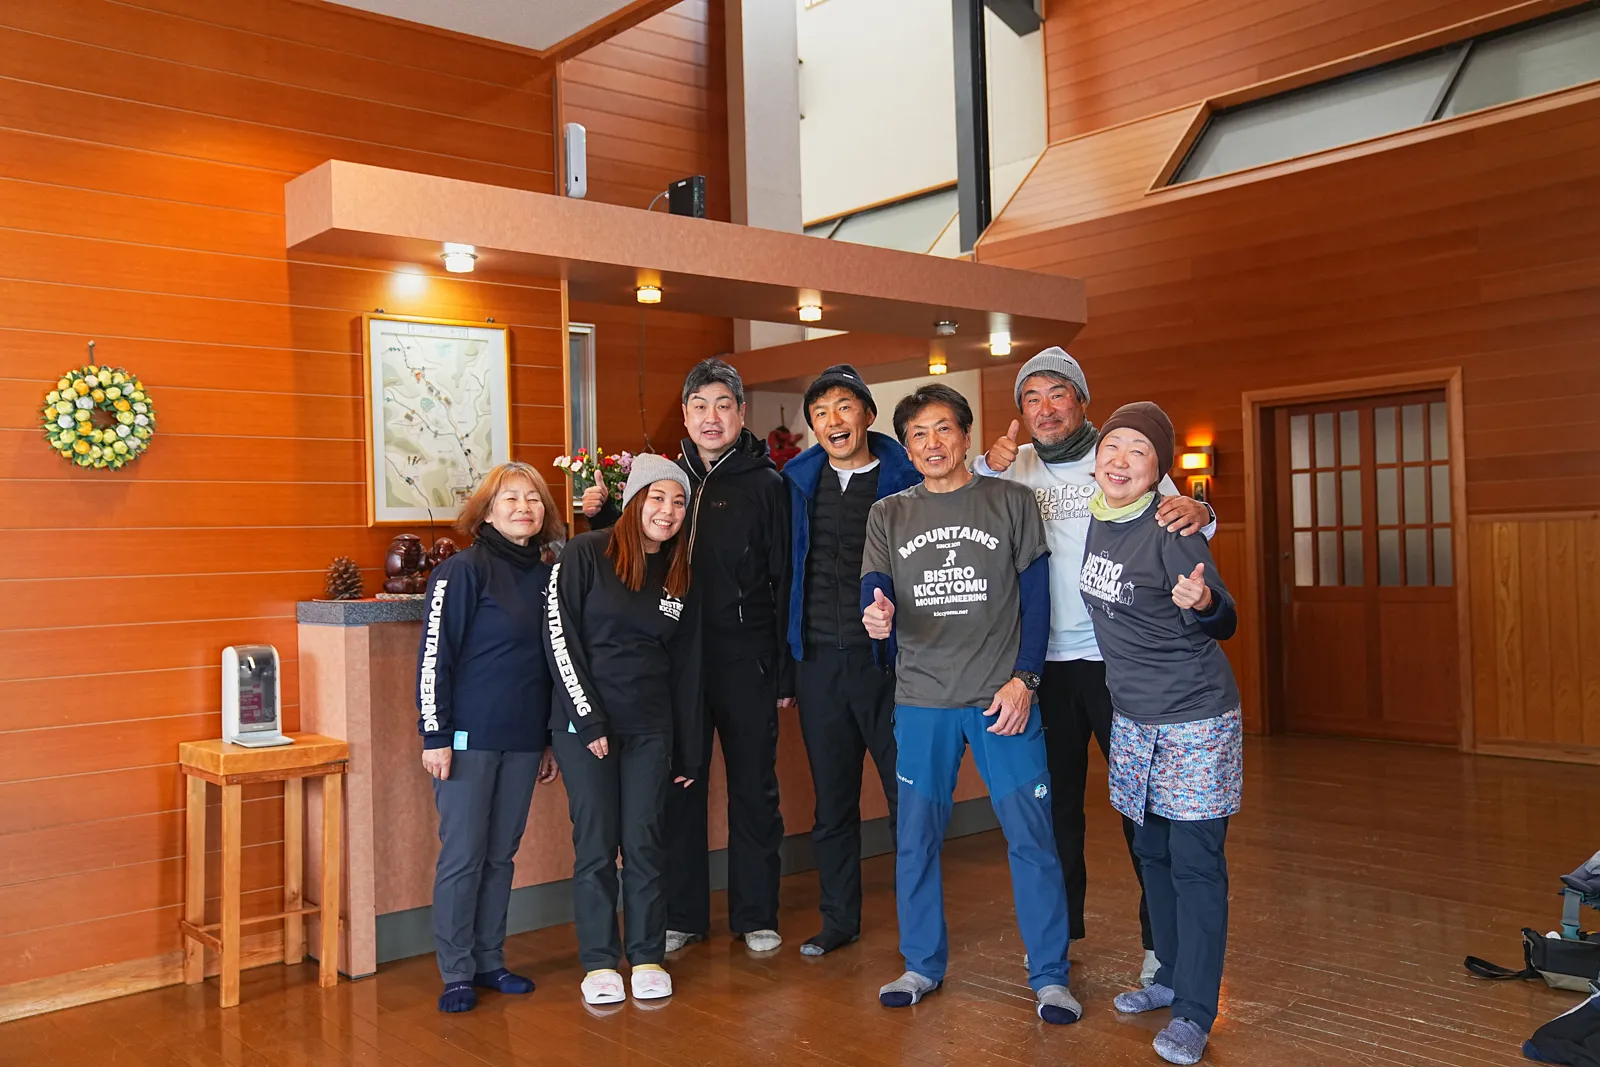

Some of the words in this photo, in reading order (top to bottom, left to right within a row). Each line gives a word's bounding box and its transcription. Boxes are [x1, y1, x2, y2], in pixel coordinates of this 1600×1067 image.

[1035, 484, 1096, 502] BISTRO
[1037, 498, 1091, 514] ICCYOM
[898, 526, 1000, 560] MOUNTAINS
[923, 566, 975, 583] BISTRO
[1083, 552, 1124, 580] BISTRO
[913, 579, 988, 598] KICCYOMU
[915, 593, 988, 607] MOUNTAINEERING
[547, 562, 592, 717] MOUNTAINEERING
[420, 579, 448, 733] MOUNTAINEERING
